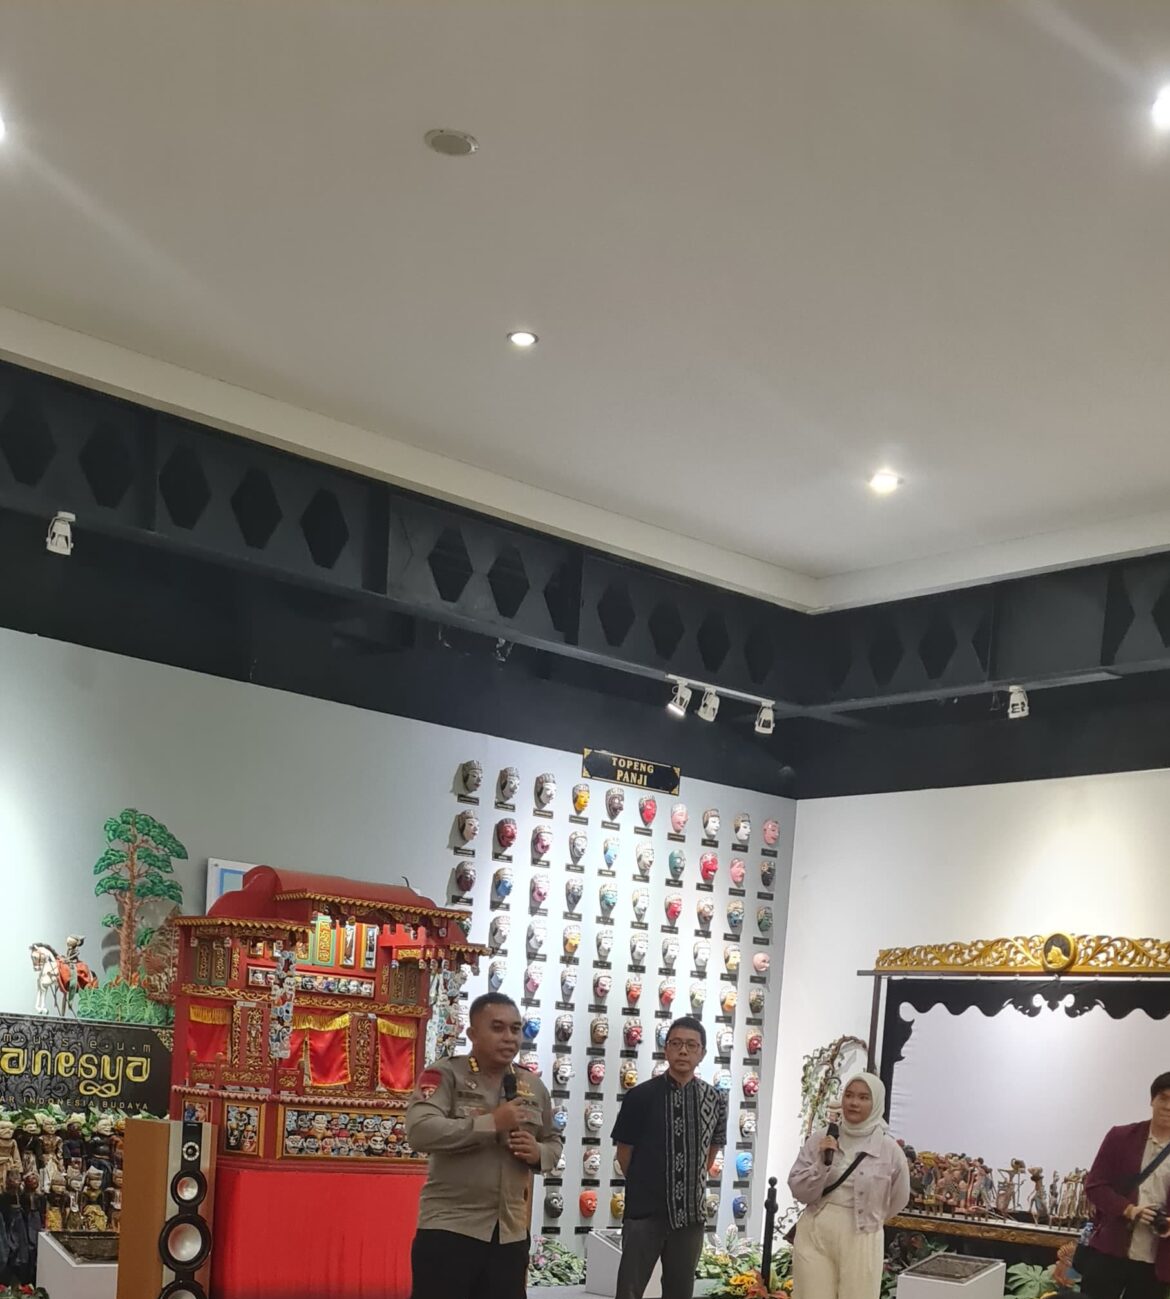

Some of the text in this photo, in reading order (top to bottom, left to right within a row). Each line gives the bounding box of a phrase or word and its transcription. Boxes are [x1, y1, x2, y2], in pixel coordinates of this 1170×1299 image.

[611, 757, 654, 774] TOPENG
[616, 769, 648, 786] PANJI
[23, 1097, 95, 1107] INDONESIA
[102, 1100, 148, 1110] BUDAYA
